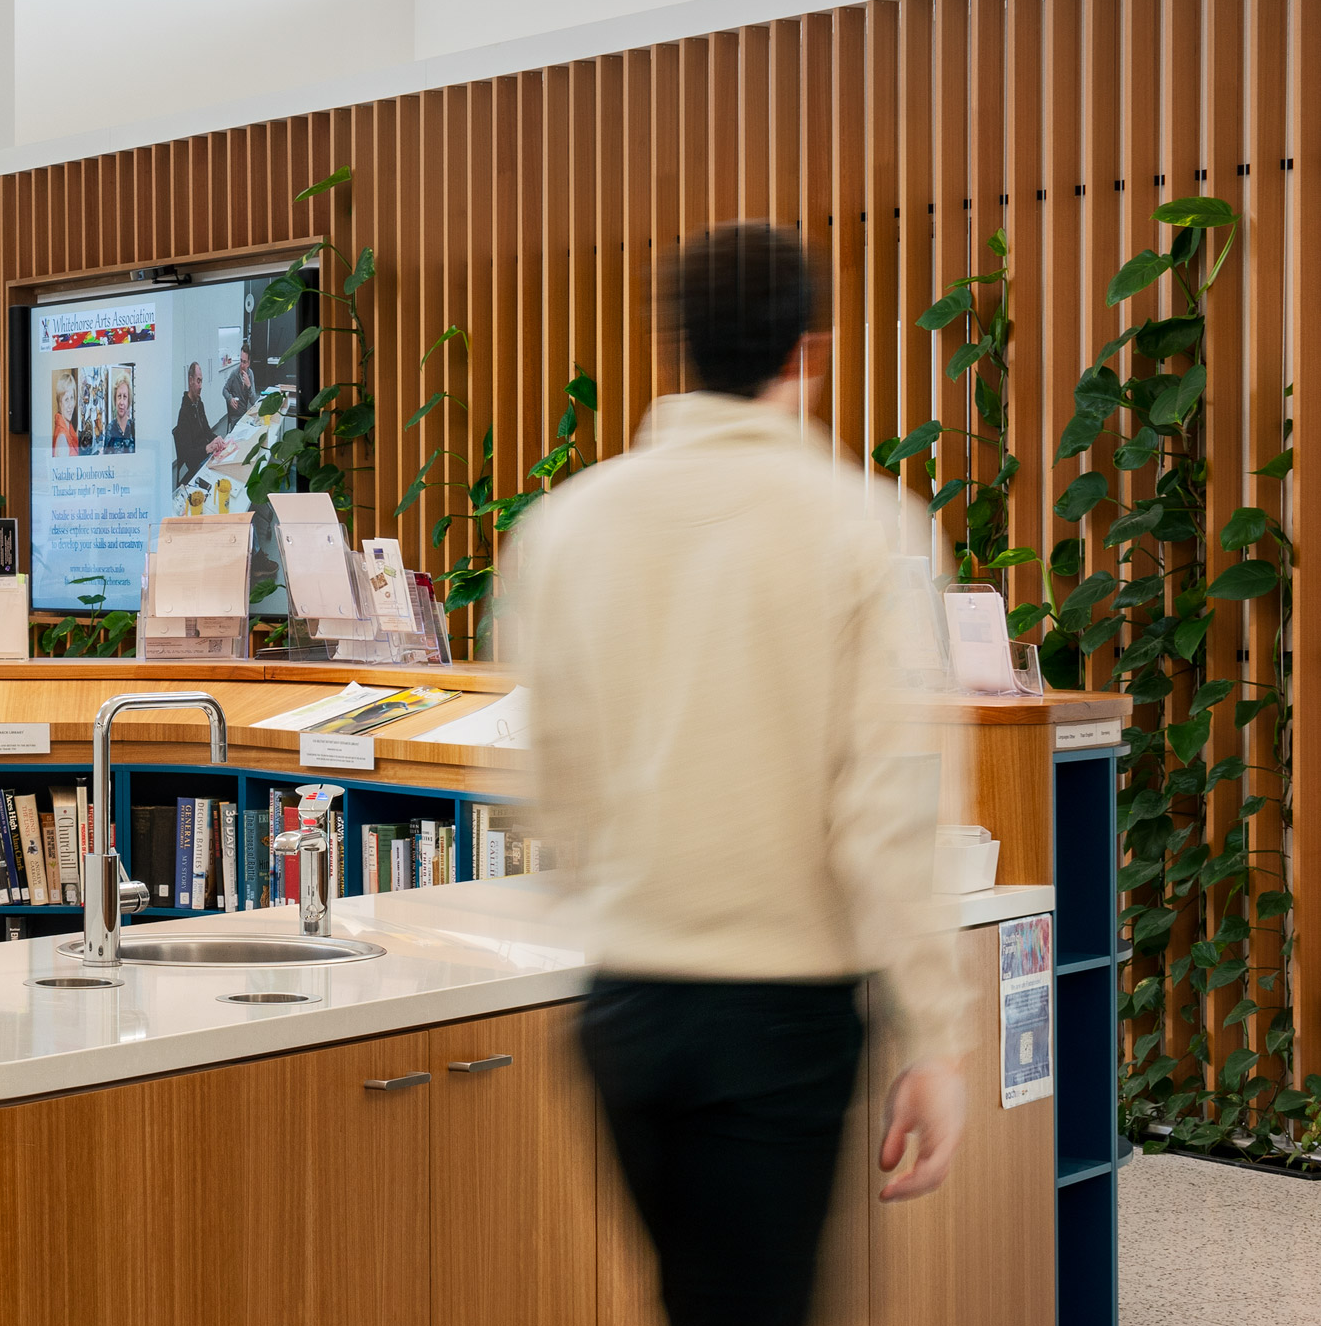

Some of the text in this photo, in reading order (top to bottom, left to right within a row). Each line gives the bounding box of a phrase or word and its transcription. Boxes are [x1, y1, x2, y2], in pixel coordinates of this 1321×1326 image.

[52, 309, 155, 333] Whitehorse Arts Association
[52, 468, 75, 481] Natalie
[52, 510, 69, 521] Natalie
[76, 508, 93, 521] skilled
[109, 508, 126, 520] media
[127, 508, 138, 519] and
[138, 507, 148, 519] her
[93, 538, 107, 549] skills
[107, 539, 118, 549] and
[119, 538, 143, 551] creativity
[6, 794, 18, 830] Aces High
[28, 808, 36, 833] BEHIND
[184, 805, 192, 847] GENERAL
[195, 802, 205, 869] DECISIVE BATTLES
[12, 833, 24, 871] Alan Clark
[58, 817, 77, 869] Churchill
[248, 861, 256, 882] Battle
